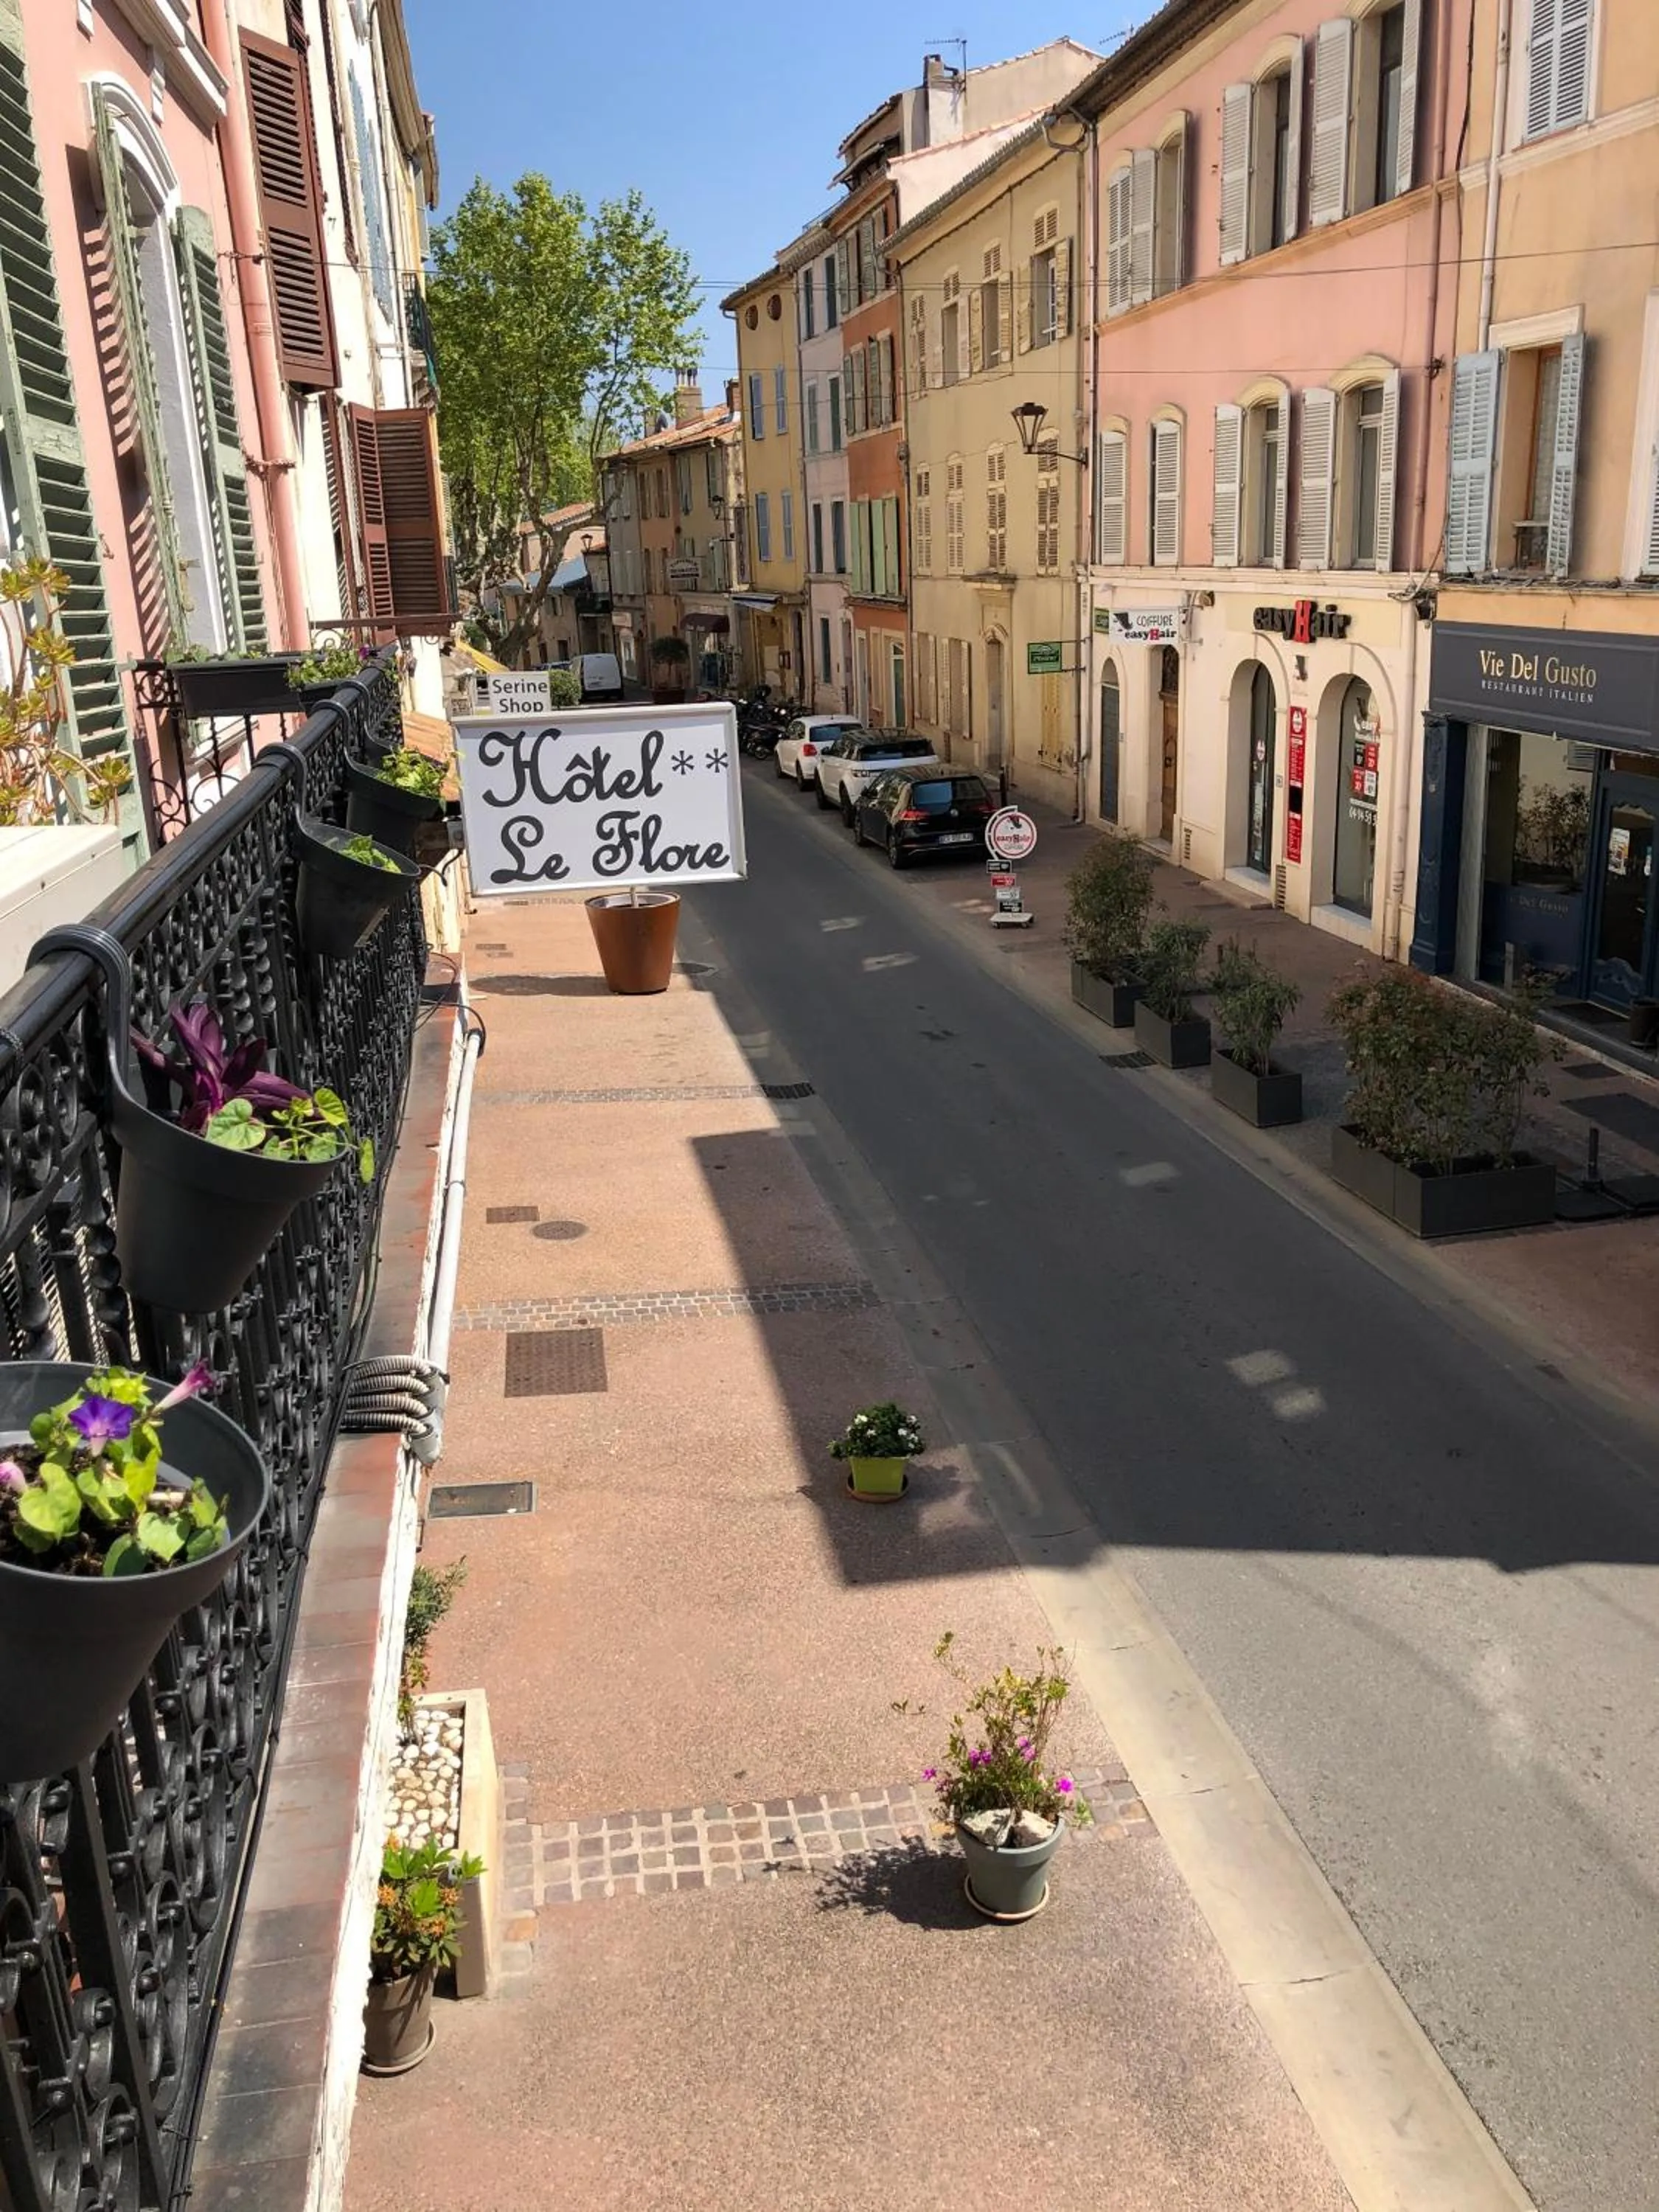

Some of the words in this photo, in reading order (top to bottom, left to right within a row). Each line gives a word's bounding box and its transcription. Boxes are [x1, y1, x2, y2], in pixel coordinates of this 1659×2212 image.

[1124, 627, 1178, 641] easyHair
[1136, 614, 1174, 627] COIFFURE
[1253, 600, 1352, 643] easyHair
[1480, 650, 1504, 677] Vie
[1510, 653, 1538, 681] Del
[1545, 656, 1597, 689] Gusto
[492, 678, 548, 694] Serine
[1481, 678, 1544, 697] RESTAURANT
[479, 728, 665, 808] Hôtel
[490, 814, 570, 884] Le
[592, 810, 731, 877] Flore
